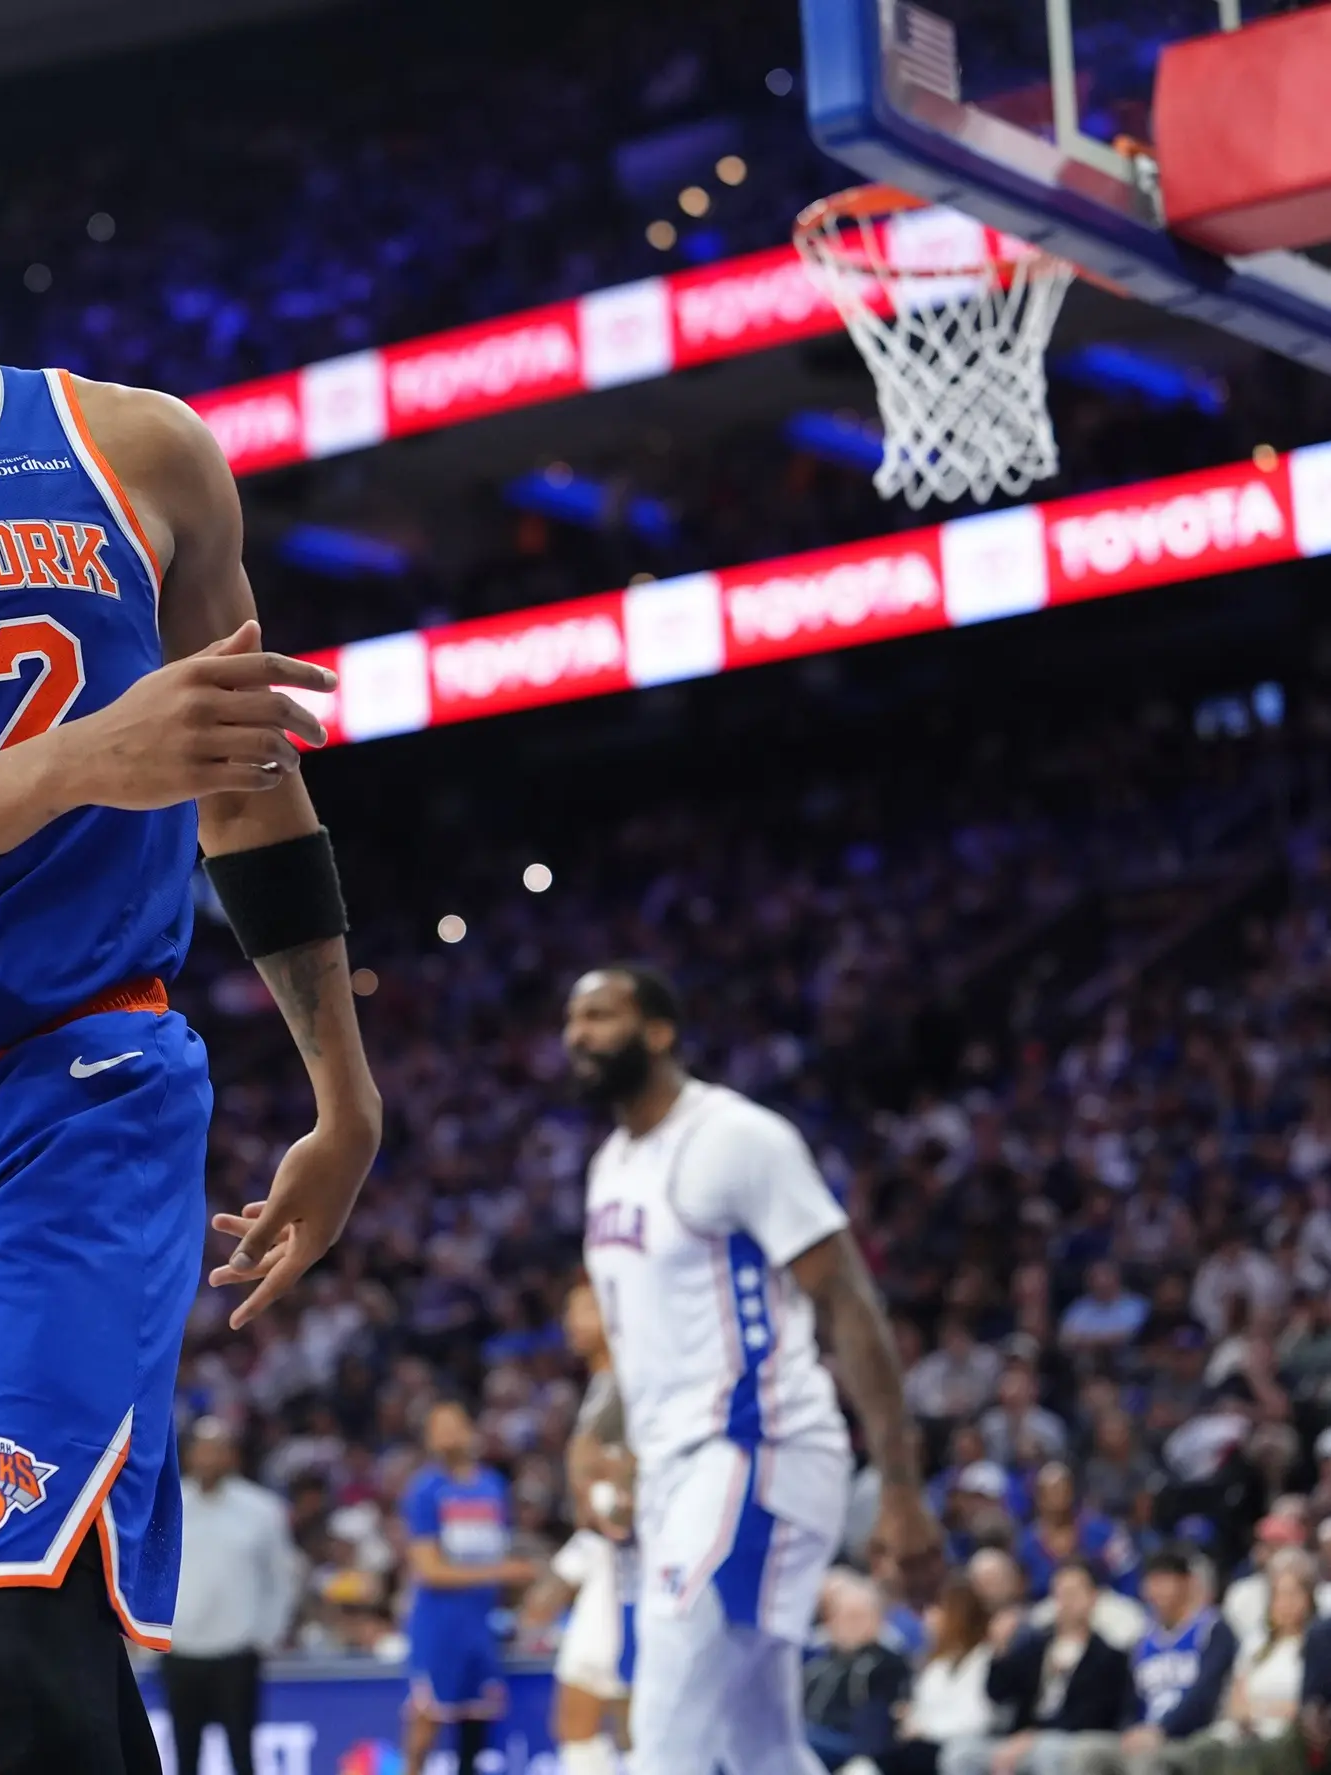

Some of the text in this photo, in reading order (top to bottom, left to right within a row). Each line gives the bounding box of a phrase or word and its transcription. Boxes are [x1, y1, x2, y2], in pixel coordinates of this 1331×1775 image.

[21, 457, 72, 471] dhabi
[1053, 481, 1284, 579] TOYOTA
[728, 552, 940, 644] TOYOTA
